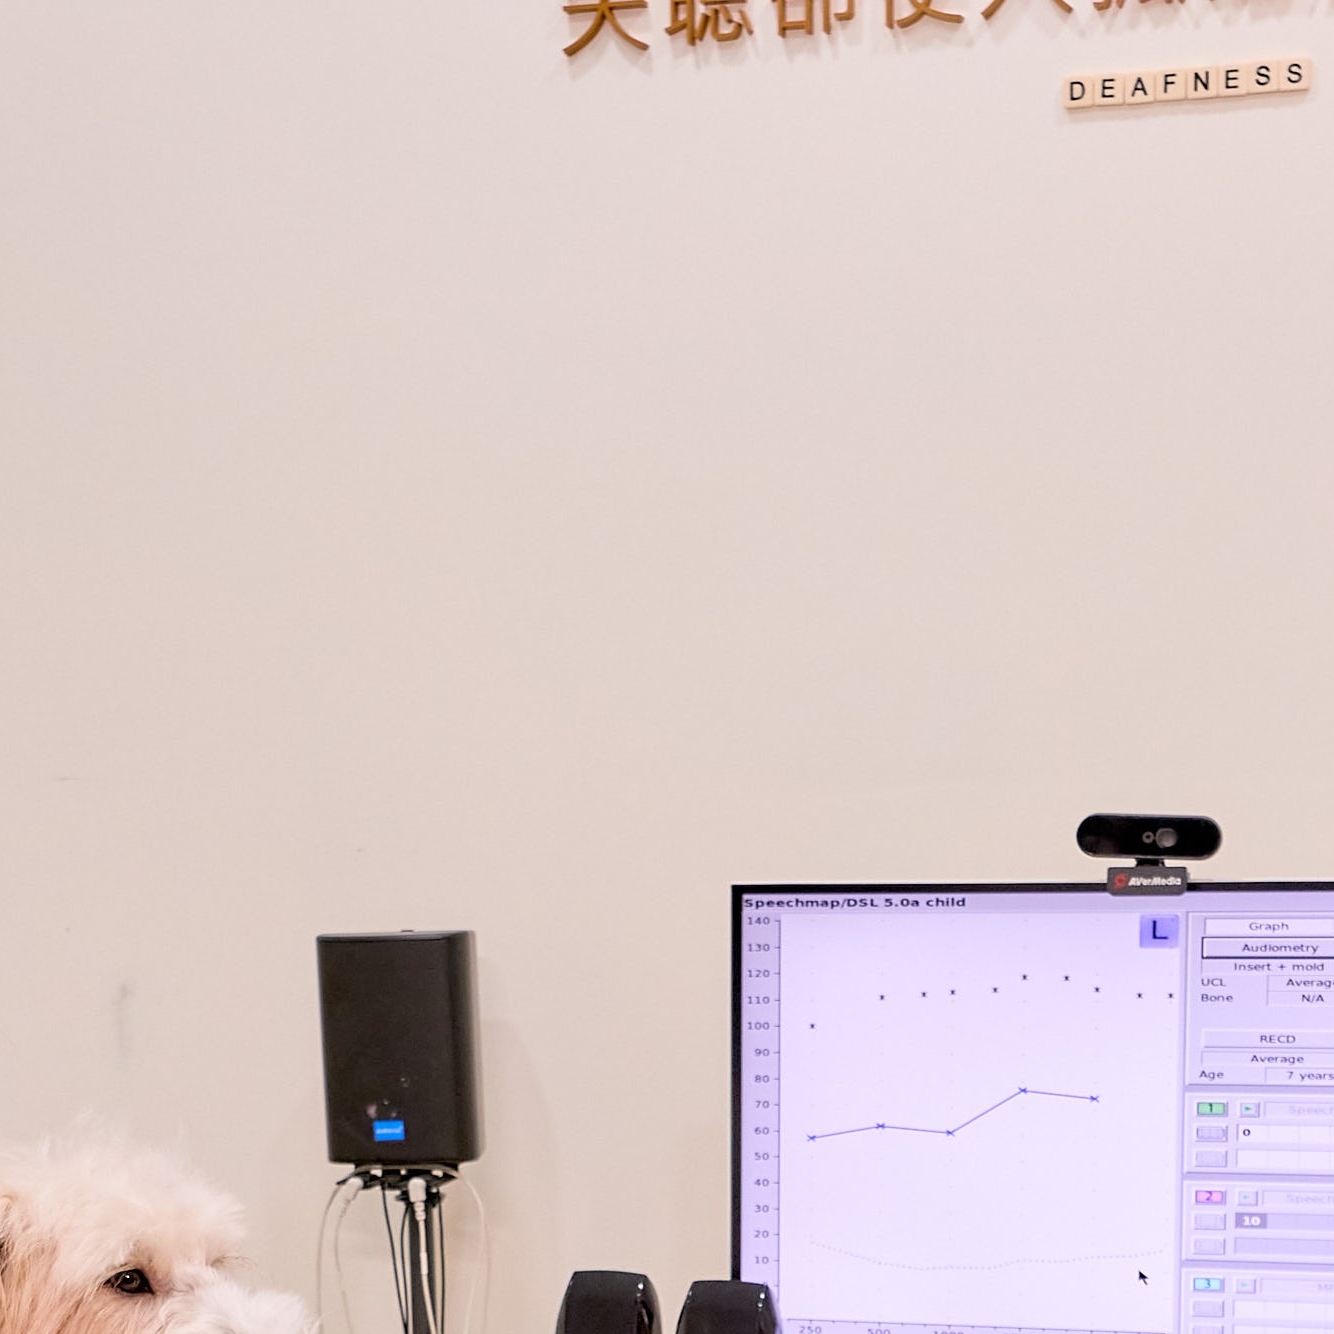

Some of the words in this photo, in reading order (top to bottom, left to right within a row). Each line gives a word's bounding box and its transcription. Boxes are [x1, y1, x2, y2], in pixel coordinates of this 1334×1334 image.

[1069, 63, 1302, 102] DEAFNESS
[744, 898, 879, 910] Speechmap/DSL
[884, 898, 920, 908] 5.0a
[925, 898, 967, 907] child
[747, 917, 770, 925] 140
[1152, 919, 1169, 939] L
[1248, 922, 1289, 932] Graph
[747, 944, 770, 952] 130
[1241, 944, 1320, 954] Audiometry
[1233, 963, 1271, 972] Insert
[1292, 963, 1324, 972] mold
[747, 970, 770, 978] 120
[1201, 978, 1227, 987] UCL
[747, 996, 770, 1004] 110
[1201, 994, 1234, 1002] Bone
[1301, 994, 1325, 1003] N/A
[747, 1022, 770, 1030] 100
[1259, 1035, 1297, 1044] RECD
[754, 1049, 770, 1057] 90
[1250, 1055, 1305, 1065] Average
[754, 1075, 770, 1083] 80
[1199, 1071, 1224, 1080] Age
[1299, 1073, 1334, 1081] years
[755, 1101, 770, 1109] 70
[754, 1127, 770, 1135] 60
[754, 1153, 770, 1161] 50
[754, 1179, 770, 1187] 40
[754, 1205, 770, 1213] 30
[1242, 1216, 1261, 1226] 10
[754, 1231, 770, 1239] 20
[755, 1256, 770, 1264] 10
[799, 1326, 822, 1334] 250
